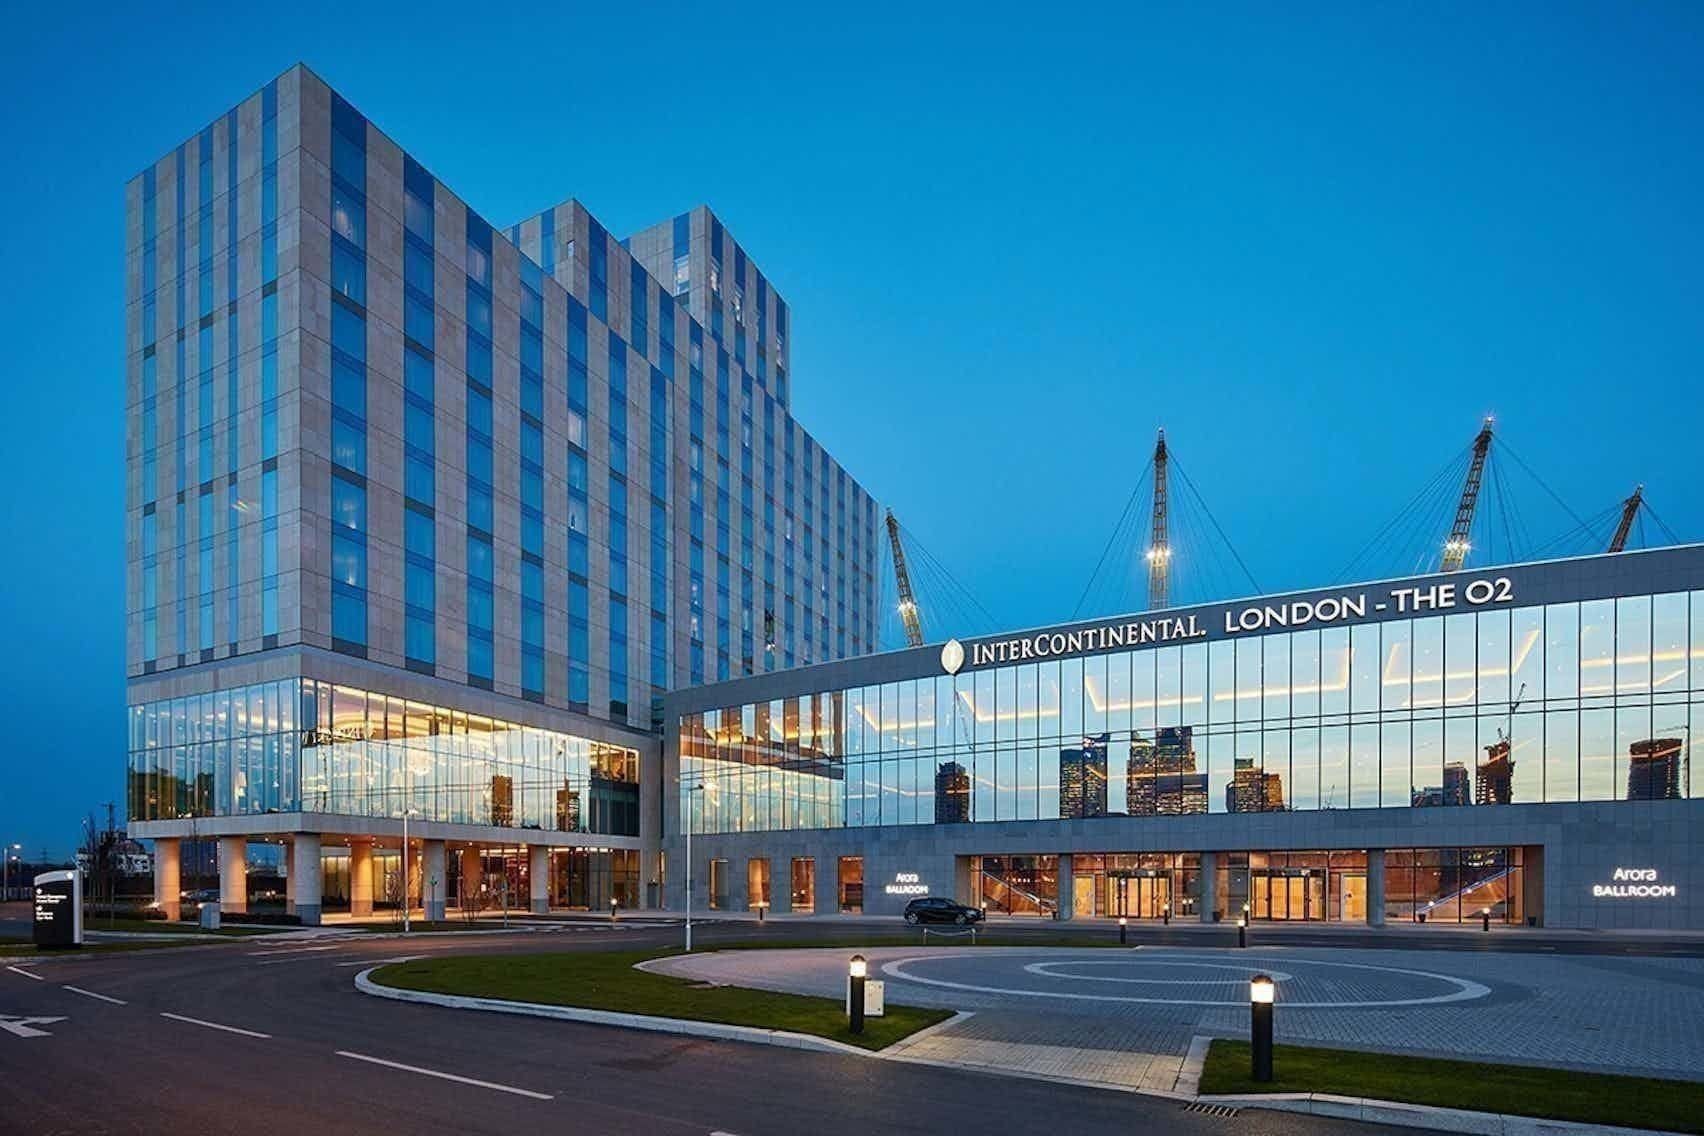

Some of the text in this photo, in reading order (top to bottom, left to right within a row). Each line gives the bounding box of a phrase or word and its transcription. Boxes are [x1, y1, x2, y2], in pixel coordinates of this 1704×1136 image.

[1225, 594, 1365, 633] LONDON
[1391, 584, 1455, 613] THE
[1613, 867, 1657, 881] Arora
[885, 885, 929, 894] BALLROOM
[1592, 884, 1676, 897] BALLROOM
